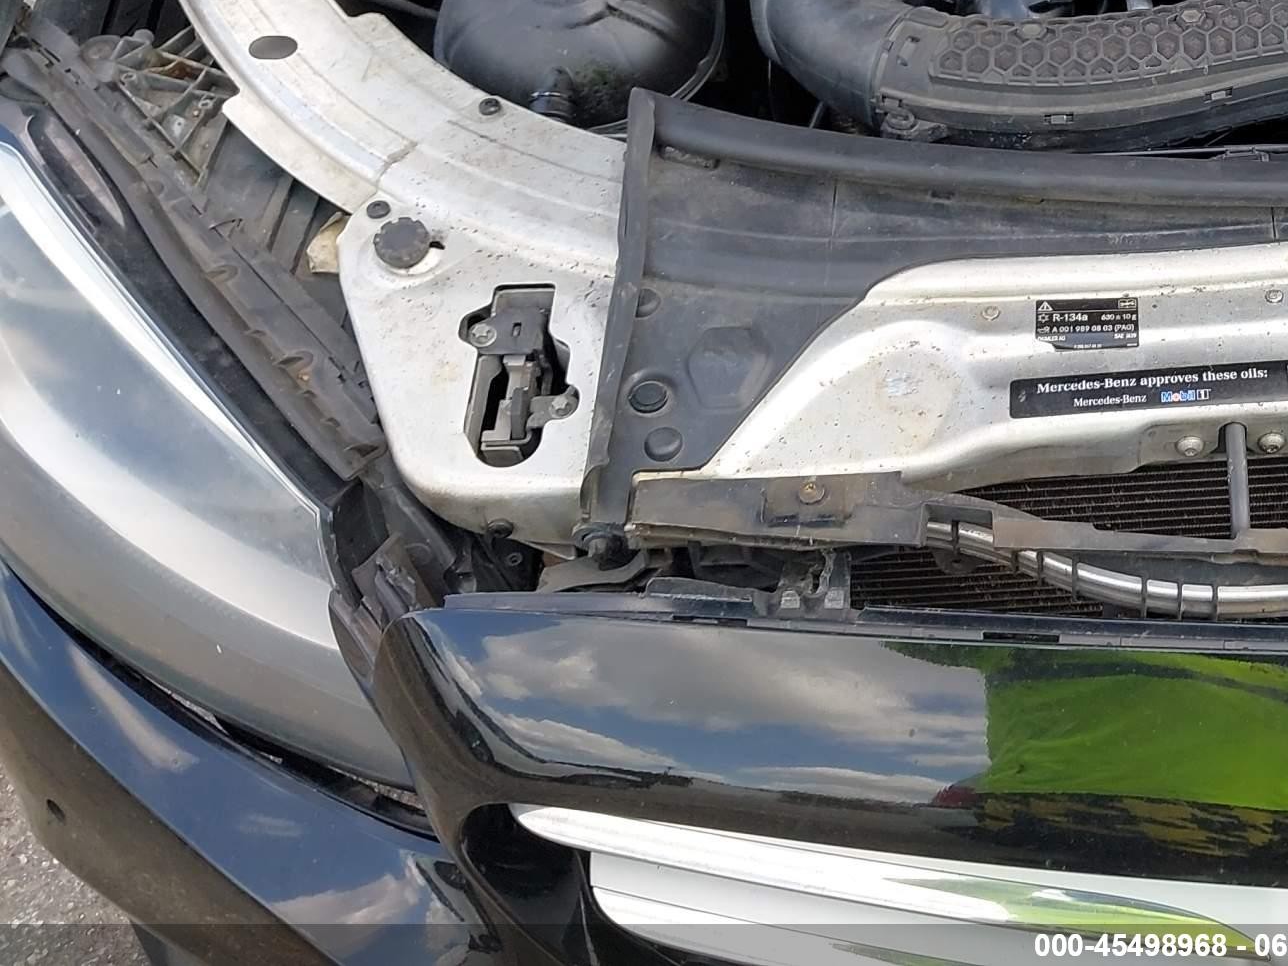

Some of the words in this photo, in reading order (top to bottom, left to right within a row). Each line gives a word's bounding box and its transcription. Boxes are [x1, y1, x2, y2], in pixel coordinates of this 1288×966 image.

[1052, 313, 1088, 322] R-134a
[1114, 324, 1134, 332] (PAG)
[1037, 378, 1136, 394] Mercedes-Benz
[1140, 373, 1198, 387] approves
[1202, 370, 1237, 382] these
[1240, 368, 1268, 378] oils:
[1073, 394, 1147, 407] Mercedes-Benz
[1160, 390, 1195, 403] Mobil
